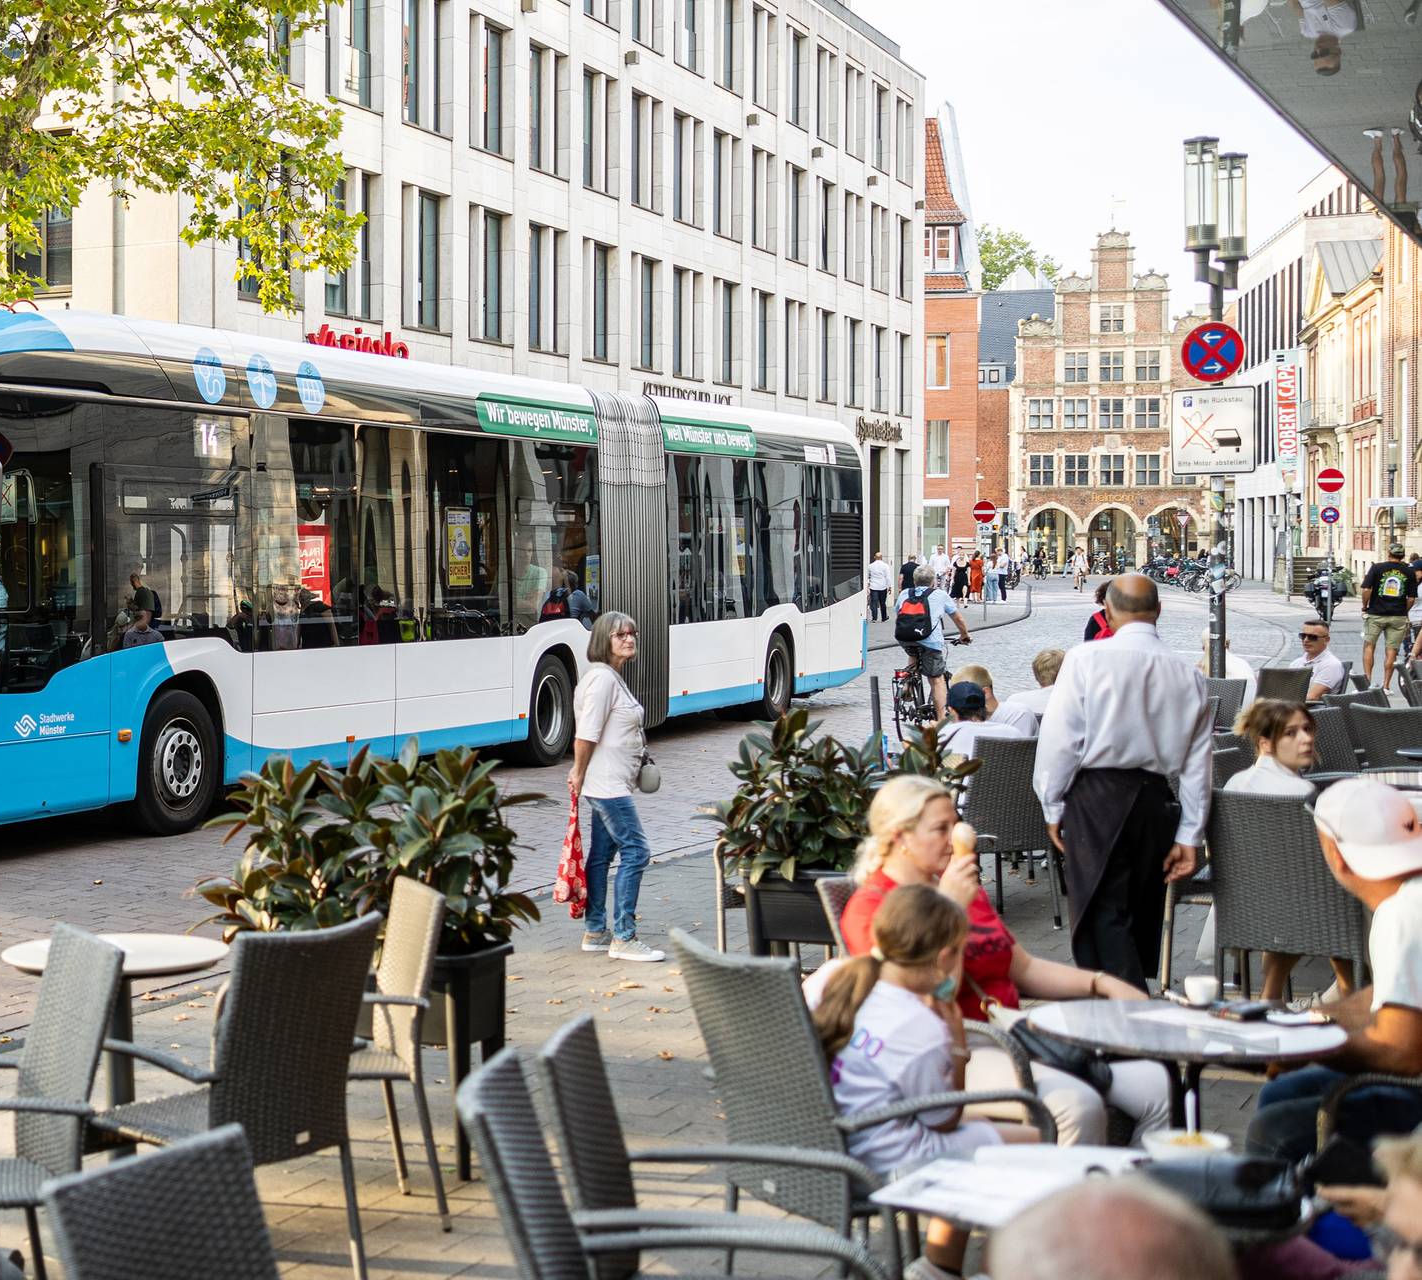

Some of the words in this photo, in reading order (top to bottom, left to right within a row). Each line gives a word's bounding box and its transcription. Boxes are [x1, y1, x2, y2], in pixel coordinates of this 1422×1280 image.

[1276, 364, 1295, 398] CAPA
[486, 402, 504, 425] Wir
[507, 406, 551, 432] bewegen
[552, 410, 592, 436] Münster,
[1278, 407, 1297, 456] ROBERT
[199, 423, 217, 456] 14
[683, 427, 713, 445] Münster
[713, 433, 727, 447] uns
[39, 712, 75, 724] Stadtwerke
[39, 725, 67, 736] Münster
